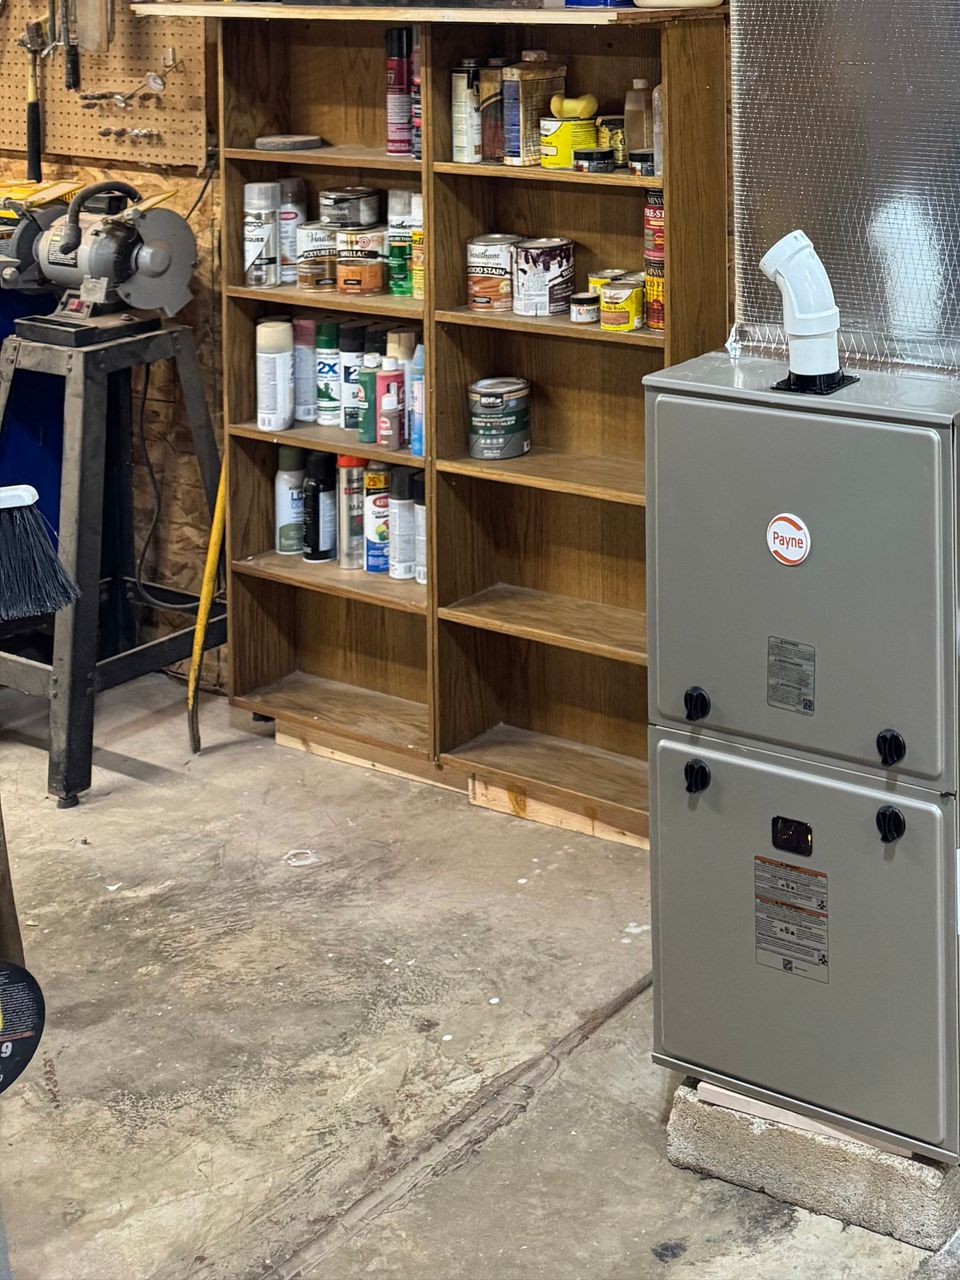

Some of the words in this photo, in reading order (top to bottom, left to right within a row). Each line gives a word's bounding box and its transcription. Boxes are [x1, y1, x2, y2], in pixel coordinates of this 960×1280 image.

[484, 268, 505, 276] STAIN
[318, 361, 338, 374] 2X
[773, 531, 804, 550] Payne
